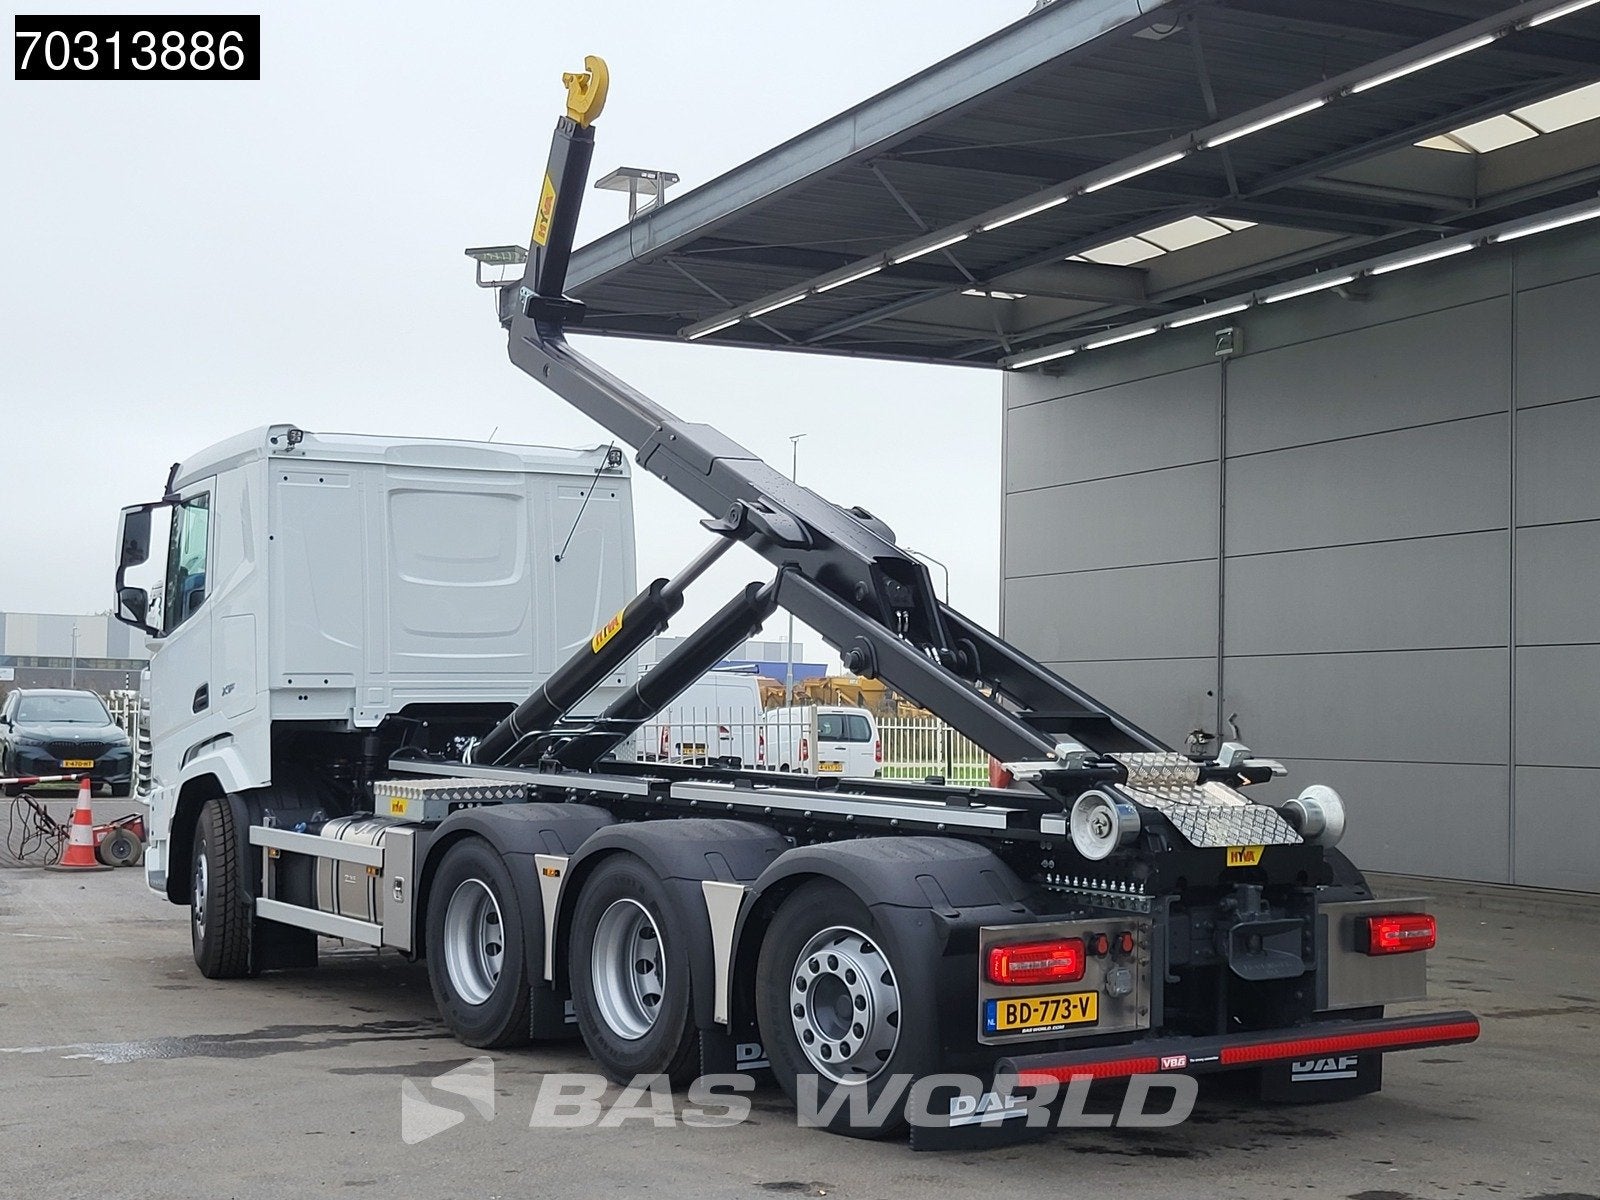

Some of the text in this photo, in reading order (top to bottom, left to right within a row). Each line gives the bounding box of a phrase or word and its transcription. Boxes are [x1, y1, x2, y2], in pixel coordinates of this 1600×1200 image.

[537, 194, 554, 239] HYVA
[1230, 846, 1255, 863] HYVA
[1006, 996, 1090, 1025] BD-773-V
[1163, 1058, 1186, 1068] VBG
[1292, 1055, 1358, 1073] DAF
[949, 1092, 1028, 1117] DAF
